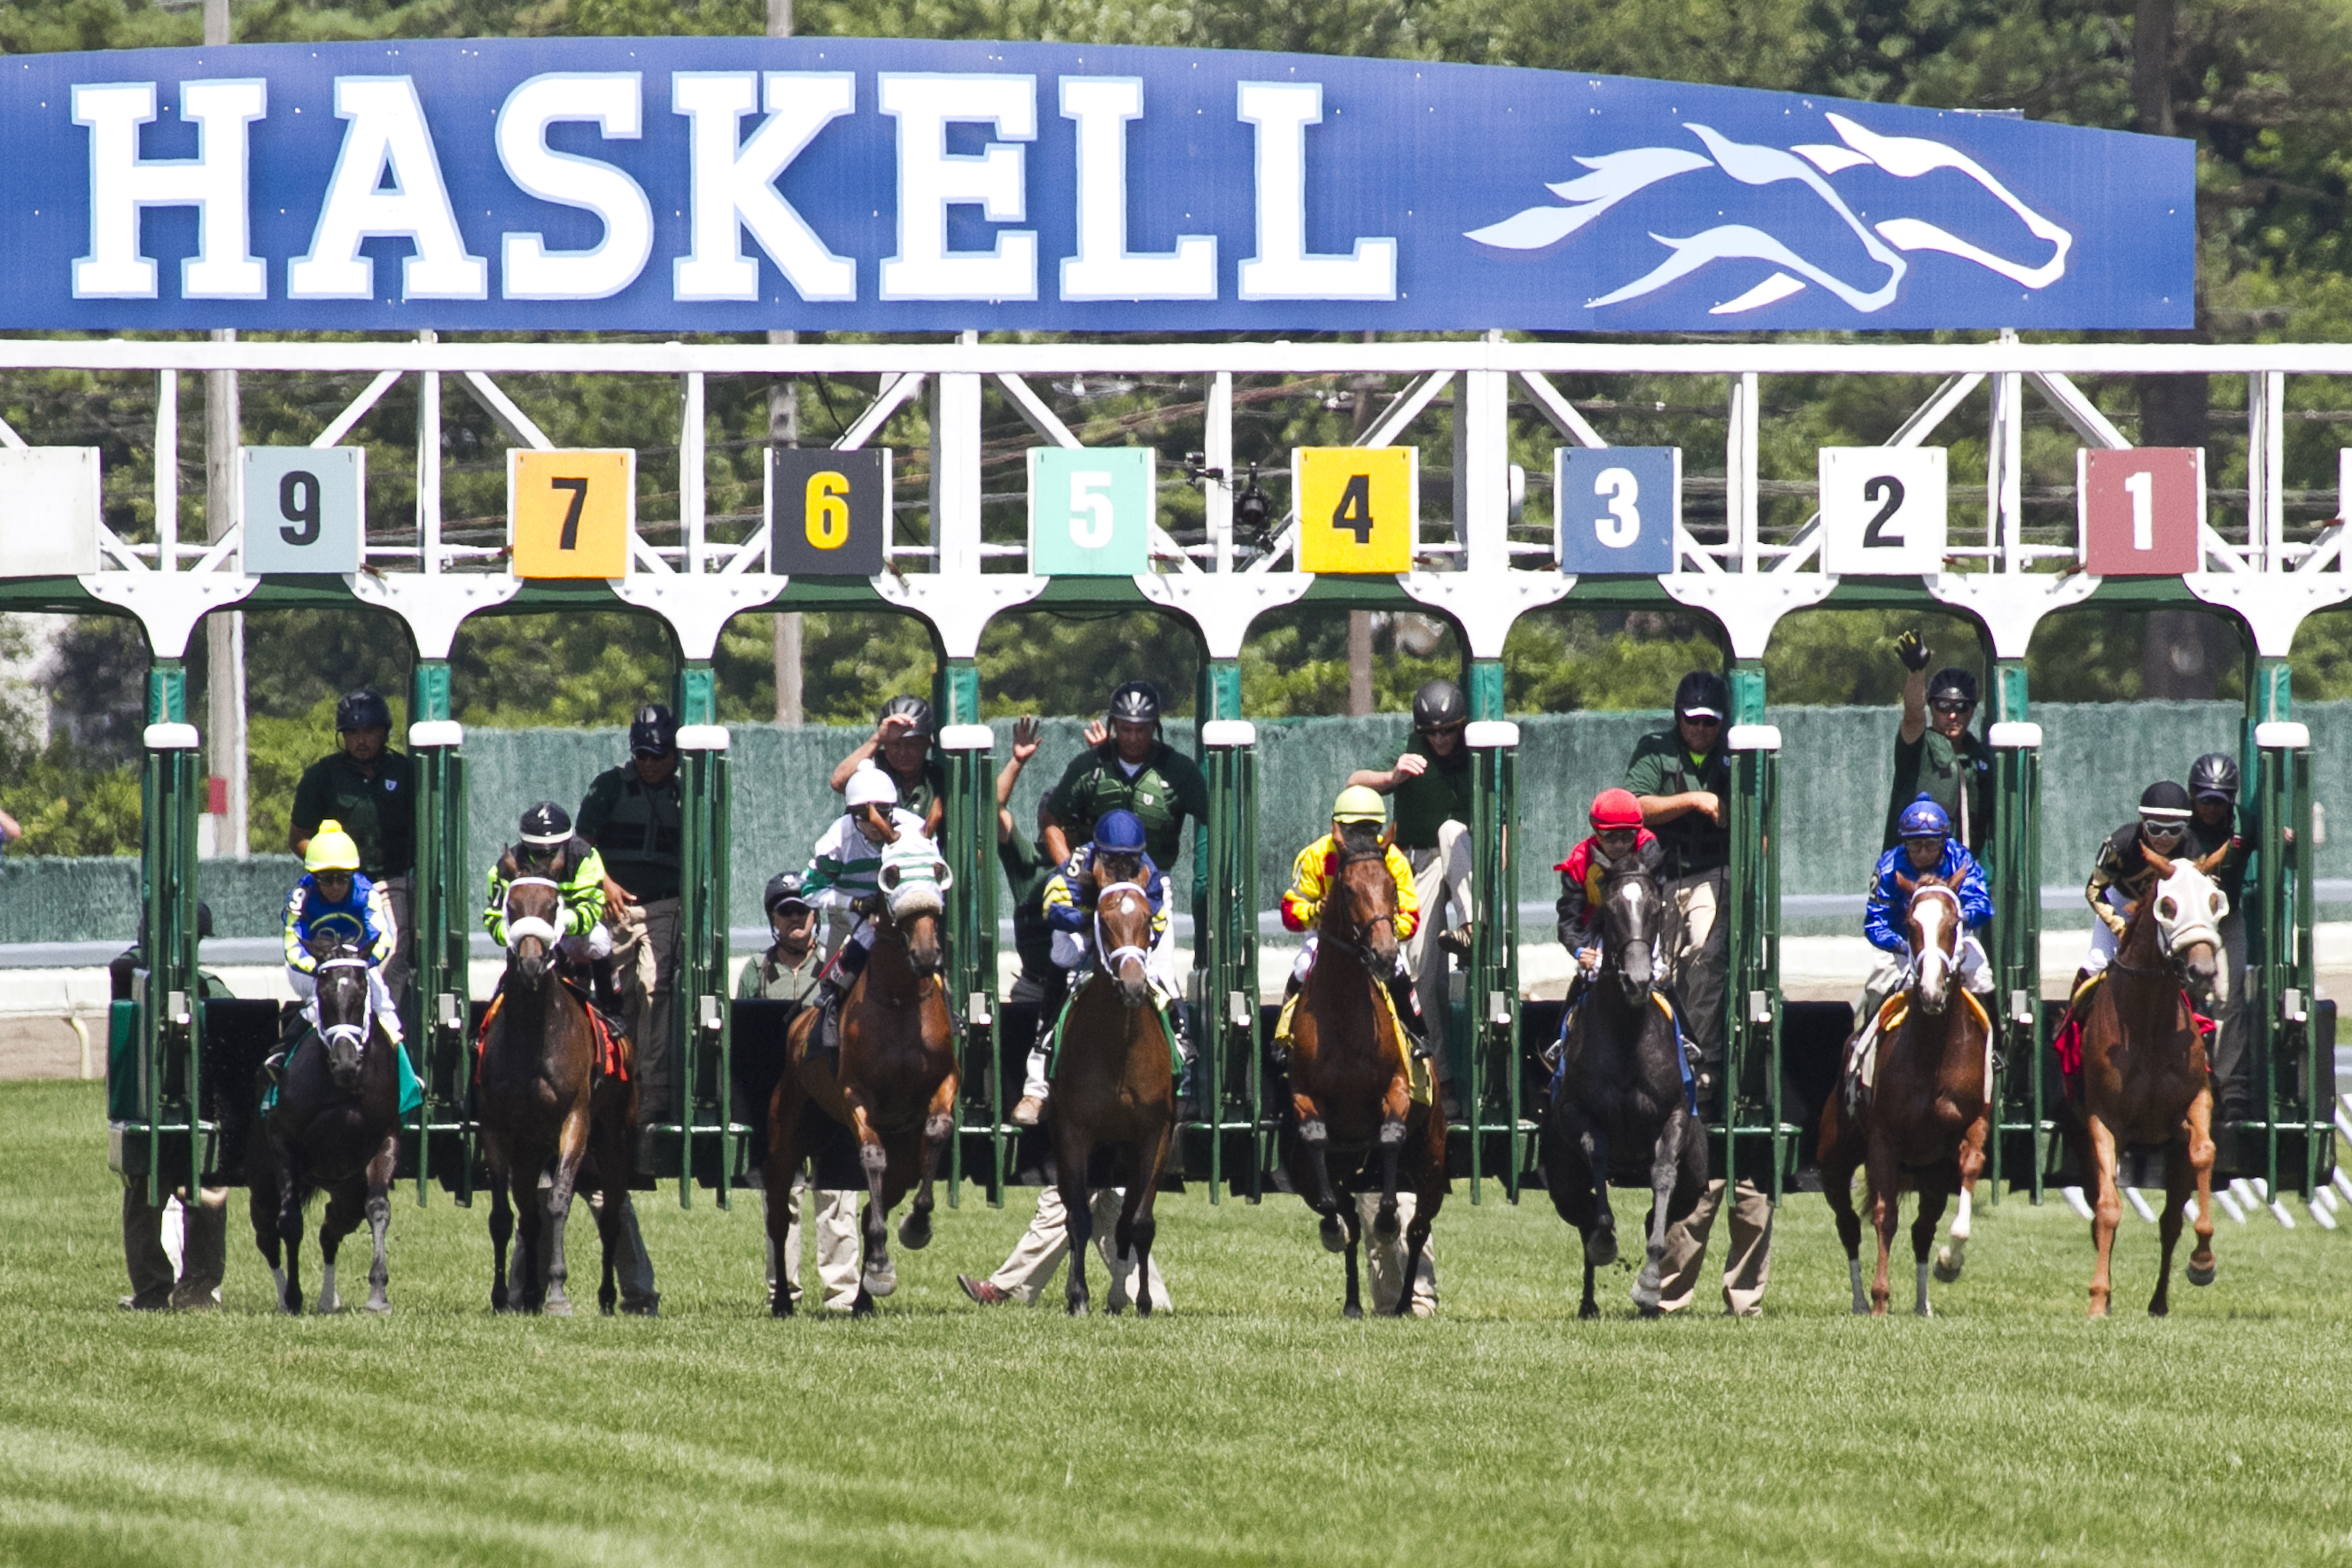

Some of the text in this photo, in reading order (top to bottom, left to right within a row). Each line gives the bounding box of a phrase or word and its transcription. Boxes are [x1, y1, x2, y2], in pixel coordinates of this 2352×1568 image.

[70, 71, 1399, 302] HASKELL
[280, 470, 321, 546] 9
[552, 477, 587, 549] 7
[804, 471, 850, 549] 6
[1069, 471, 1114, 549] 5
[1332, 474, 1373, 544] 4
[1594, 468, 1640, 548] 3
[1863, 476, 1904, 547] 2
[2124, 471, 2153, 550] 1
[289, 888, 307, 911] 9
[493, 883, 502, 907] 7
[1067, 851, 1084, 877] 5
